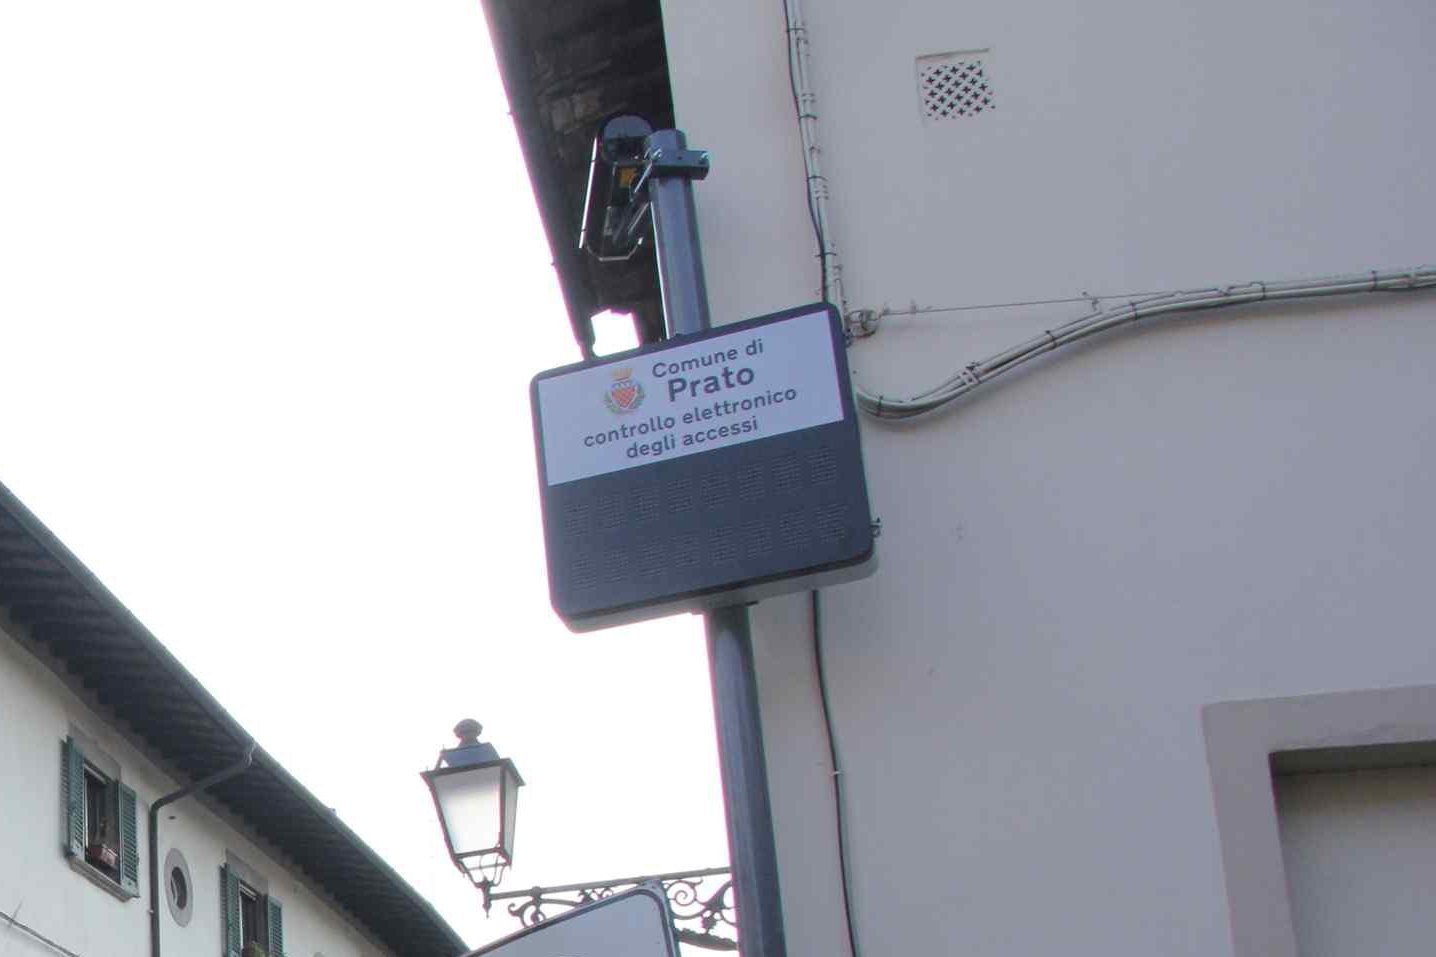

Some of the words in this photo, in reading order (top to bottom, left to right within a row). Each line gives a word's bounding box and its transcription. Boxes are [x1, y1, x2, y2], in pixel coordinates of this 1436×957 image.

[652, 347, 738, 379] Comune
[745, 338, 764, 358] di
[667, 367, 755, 402] Prato
[584, 414, 676, 448] controllo
[681, 385, 797, 426] elettronico
[626, 433, 676, 460] degli
[683, 416, 759, 447] accessi
